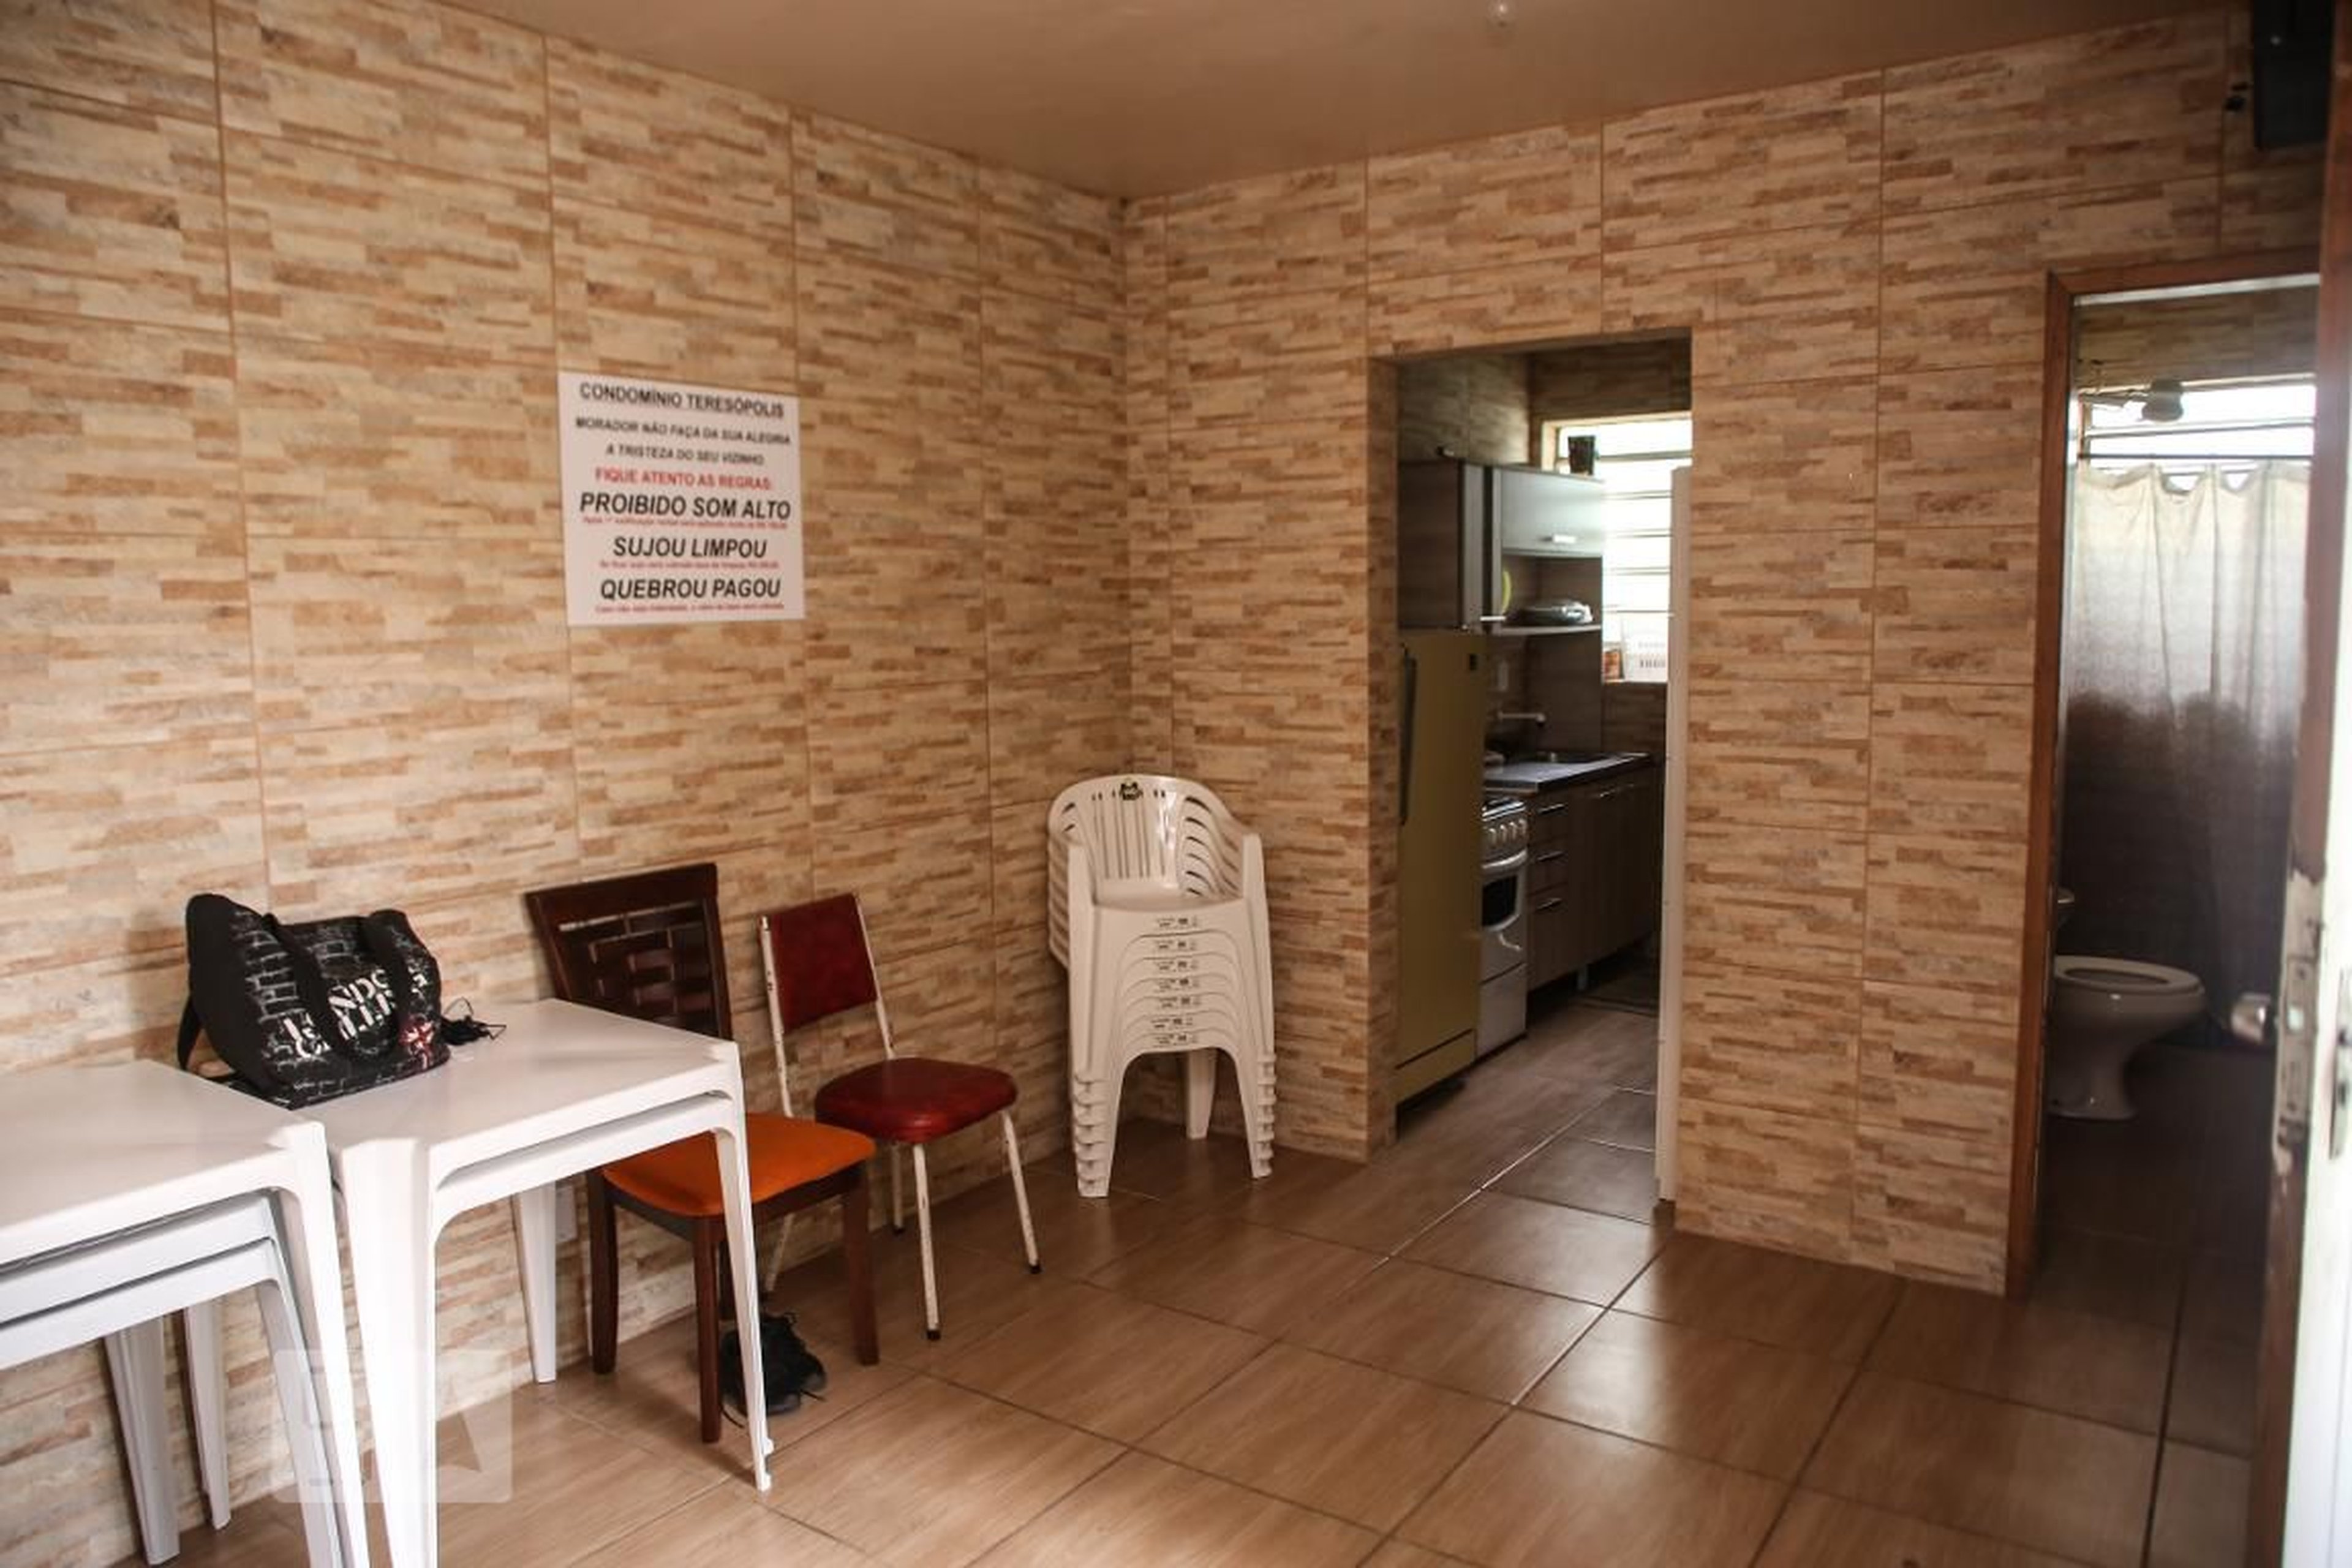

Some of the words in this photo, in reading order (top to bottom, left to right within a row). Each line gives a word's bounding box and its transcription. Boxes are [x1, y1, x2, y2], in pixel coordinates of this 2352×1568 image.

[580, 382, 682, 408] CONDOMÍNIO
[687, 394, 785, 418] TERESÓPOLIS
[576, 417, 638, 431] MORADOR
[619, 444, 674, 459] TRISTEZA
[677, 448, 694, 460] DO
[595, 467, 636, 484] FIQUE
[642, 470, 695, 487] ATENTO
[579, 492, 687, 517] PROIBIDO
[692, 497, 737, 518] SOM
[742, 500, 791, 520] ALTO
[613, 536, 686, 557] SUJOU
[691, 538, 767, 558] LIMPOU
[600, 579, 707, 600] QUEBROU
[713, 579, 781, 598] PAGOU
